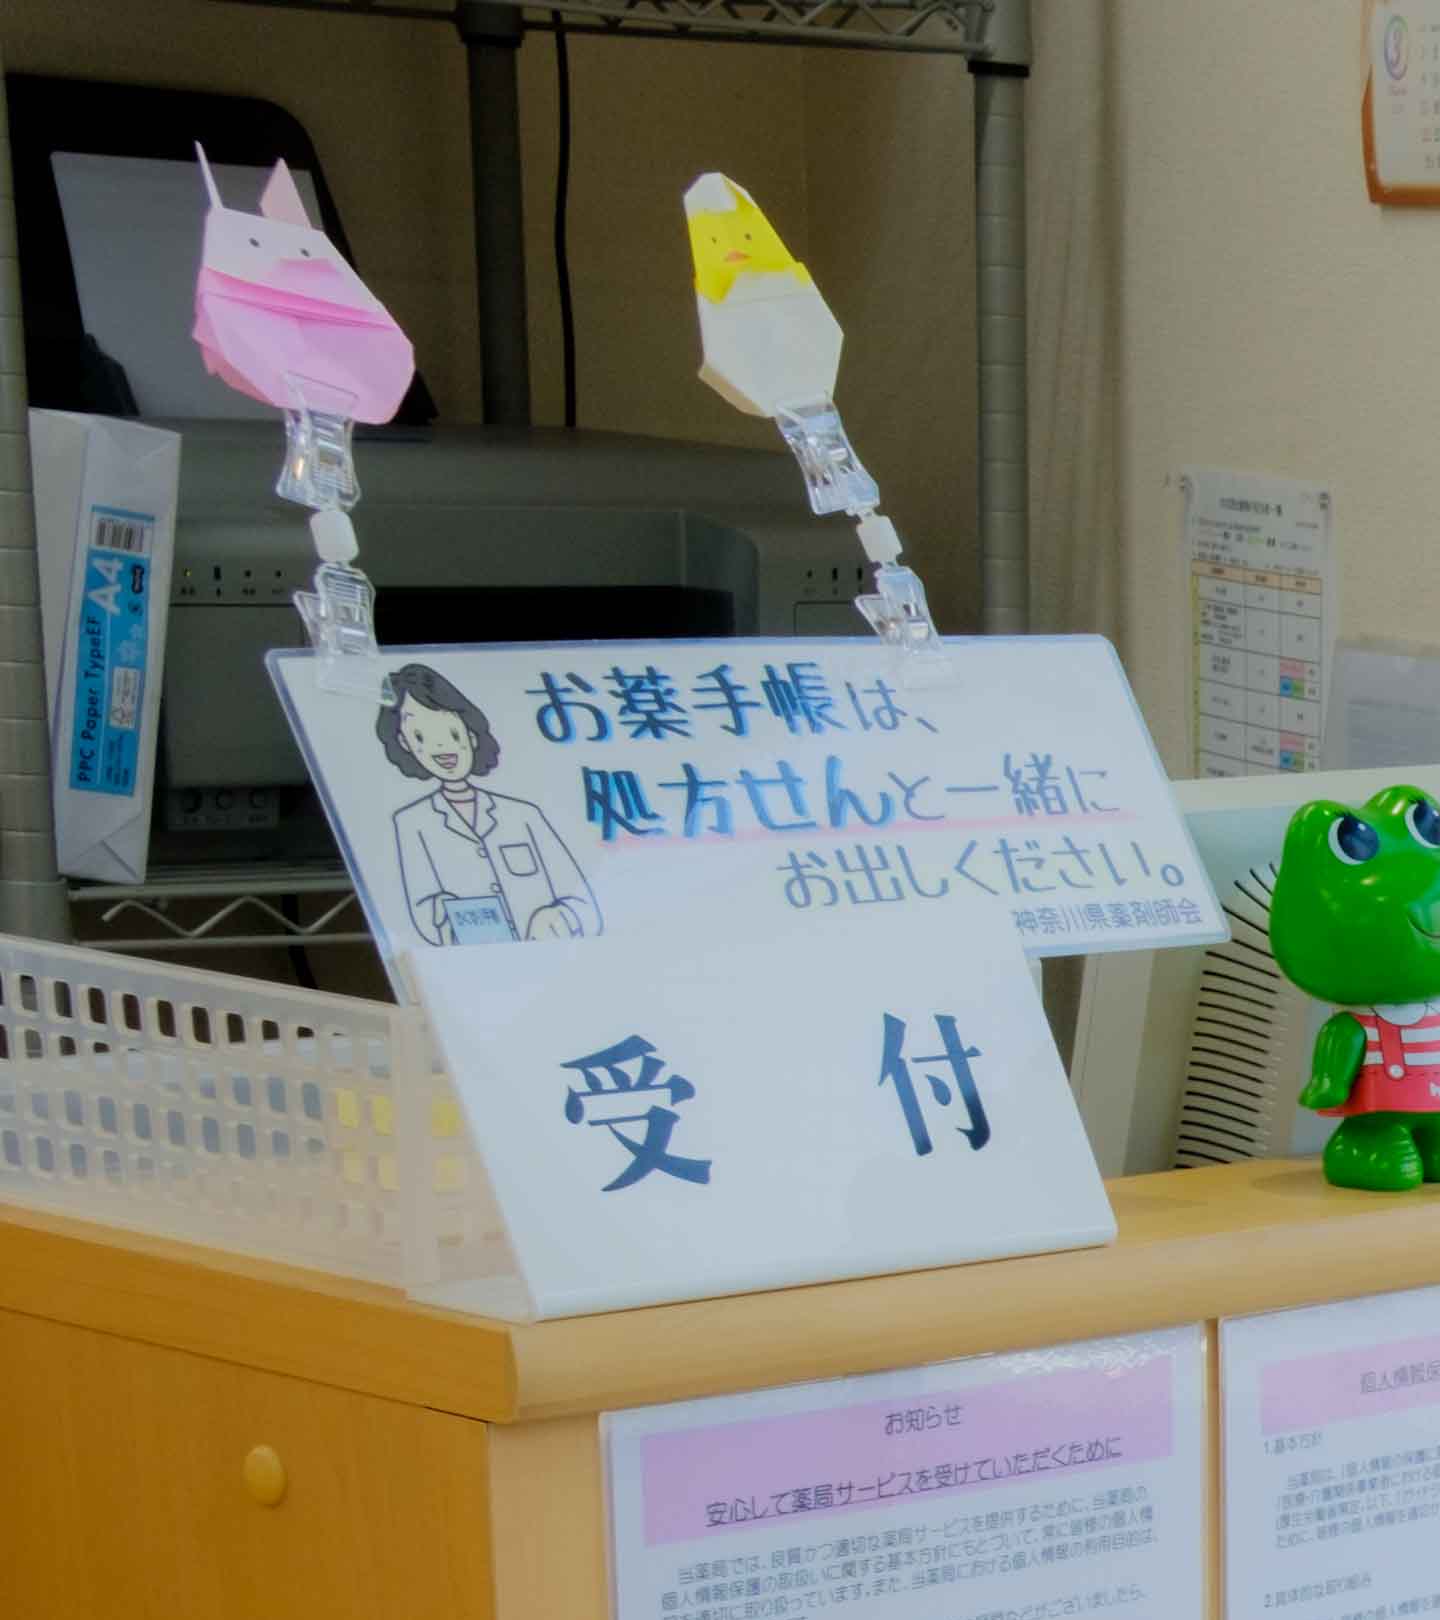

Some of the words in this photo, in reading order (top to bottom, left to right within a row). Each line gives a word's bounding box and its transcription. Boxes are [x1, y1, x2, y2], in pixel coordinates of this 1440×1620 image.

[88, 557, 124, 616] A4
[81, 688, 101, 742] Paper
[525, 662, 938, 743] お薬手帳は、
[77, 748, 92, 784] PPC
[582, 752, 1120, 842] 処方せんと一緒に
[776, 839, 1185, 908] お出しください。
[1013, 900, 1202, 937] 神奈川県薬剤師会
[884, 1400, 961, 1438] お知らせ
[705, 1435, 1122, 1528] 安心して薬局サービスを受けていただくために
